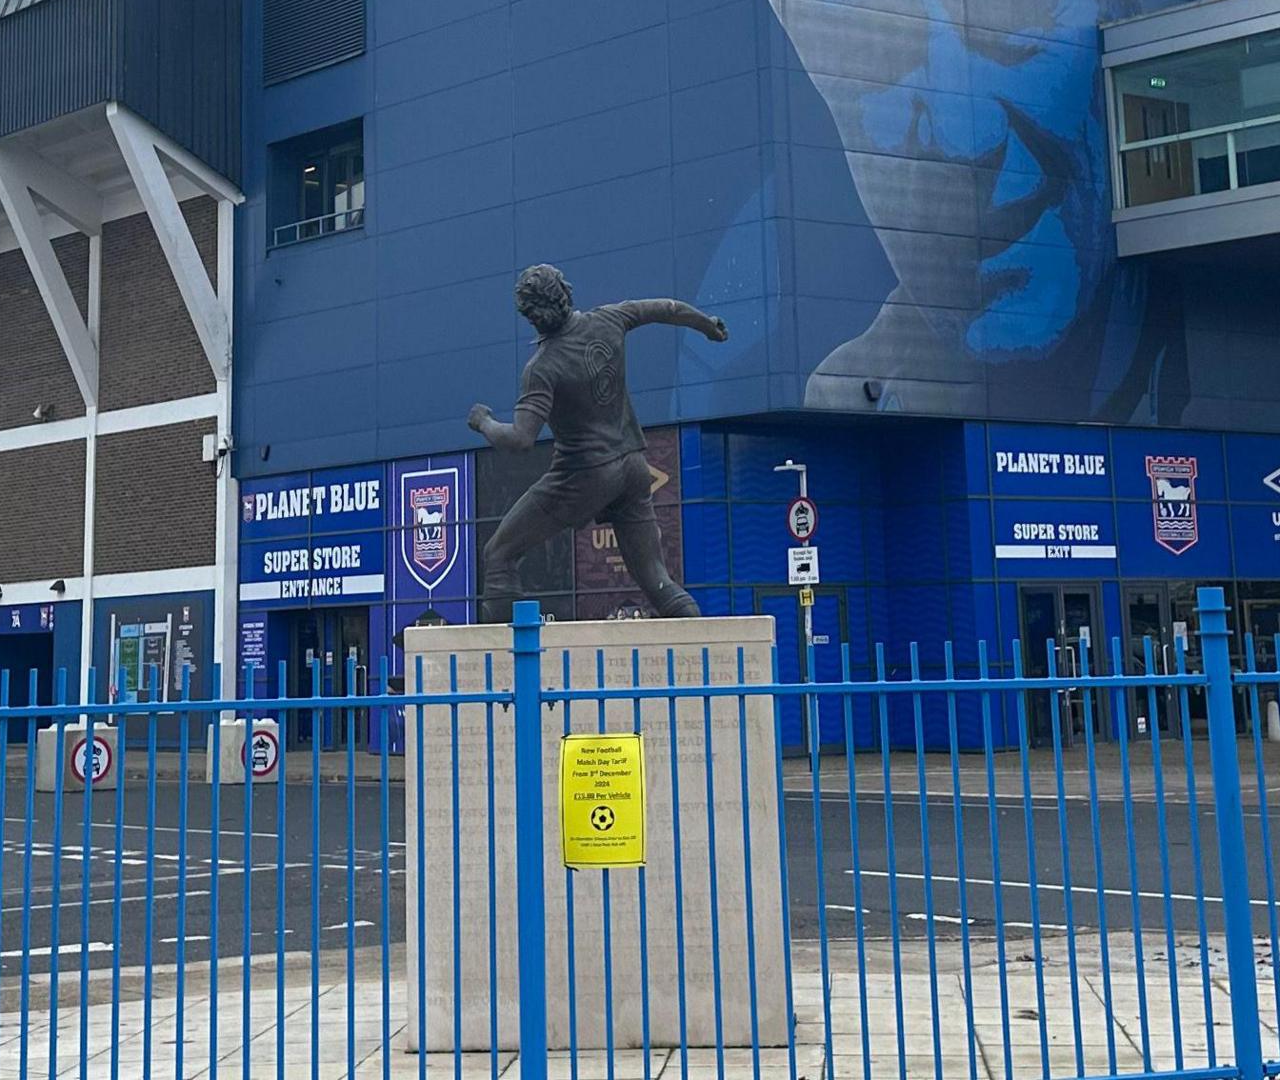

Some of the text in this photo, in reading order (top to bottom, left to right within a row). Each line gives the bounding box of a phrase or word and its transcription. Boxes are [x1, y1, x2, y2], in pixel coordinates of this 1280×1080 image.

[996, 452, 1105, 475] PLANET BLUE
[255, 480, 380, 521] PLANET BLUE
[1013, 523, 1099, 541] SUPER STORE
[1047, 545, 1070, 558] EXIT
[264, 545, 361, 574] SUPER STORE
[282, 577, 341, 599] ENTRANCE
[597, 746, 622, 754] Football
[577, 758, 597, 766] Match
[598, 759, 610, 767] Day
[599, 770, 632, 778] December
[608, 792, 632, 800] Vehicle
